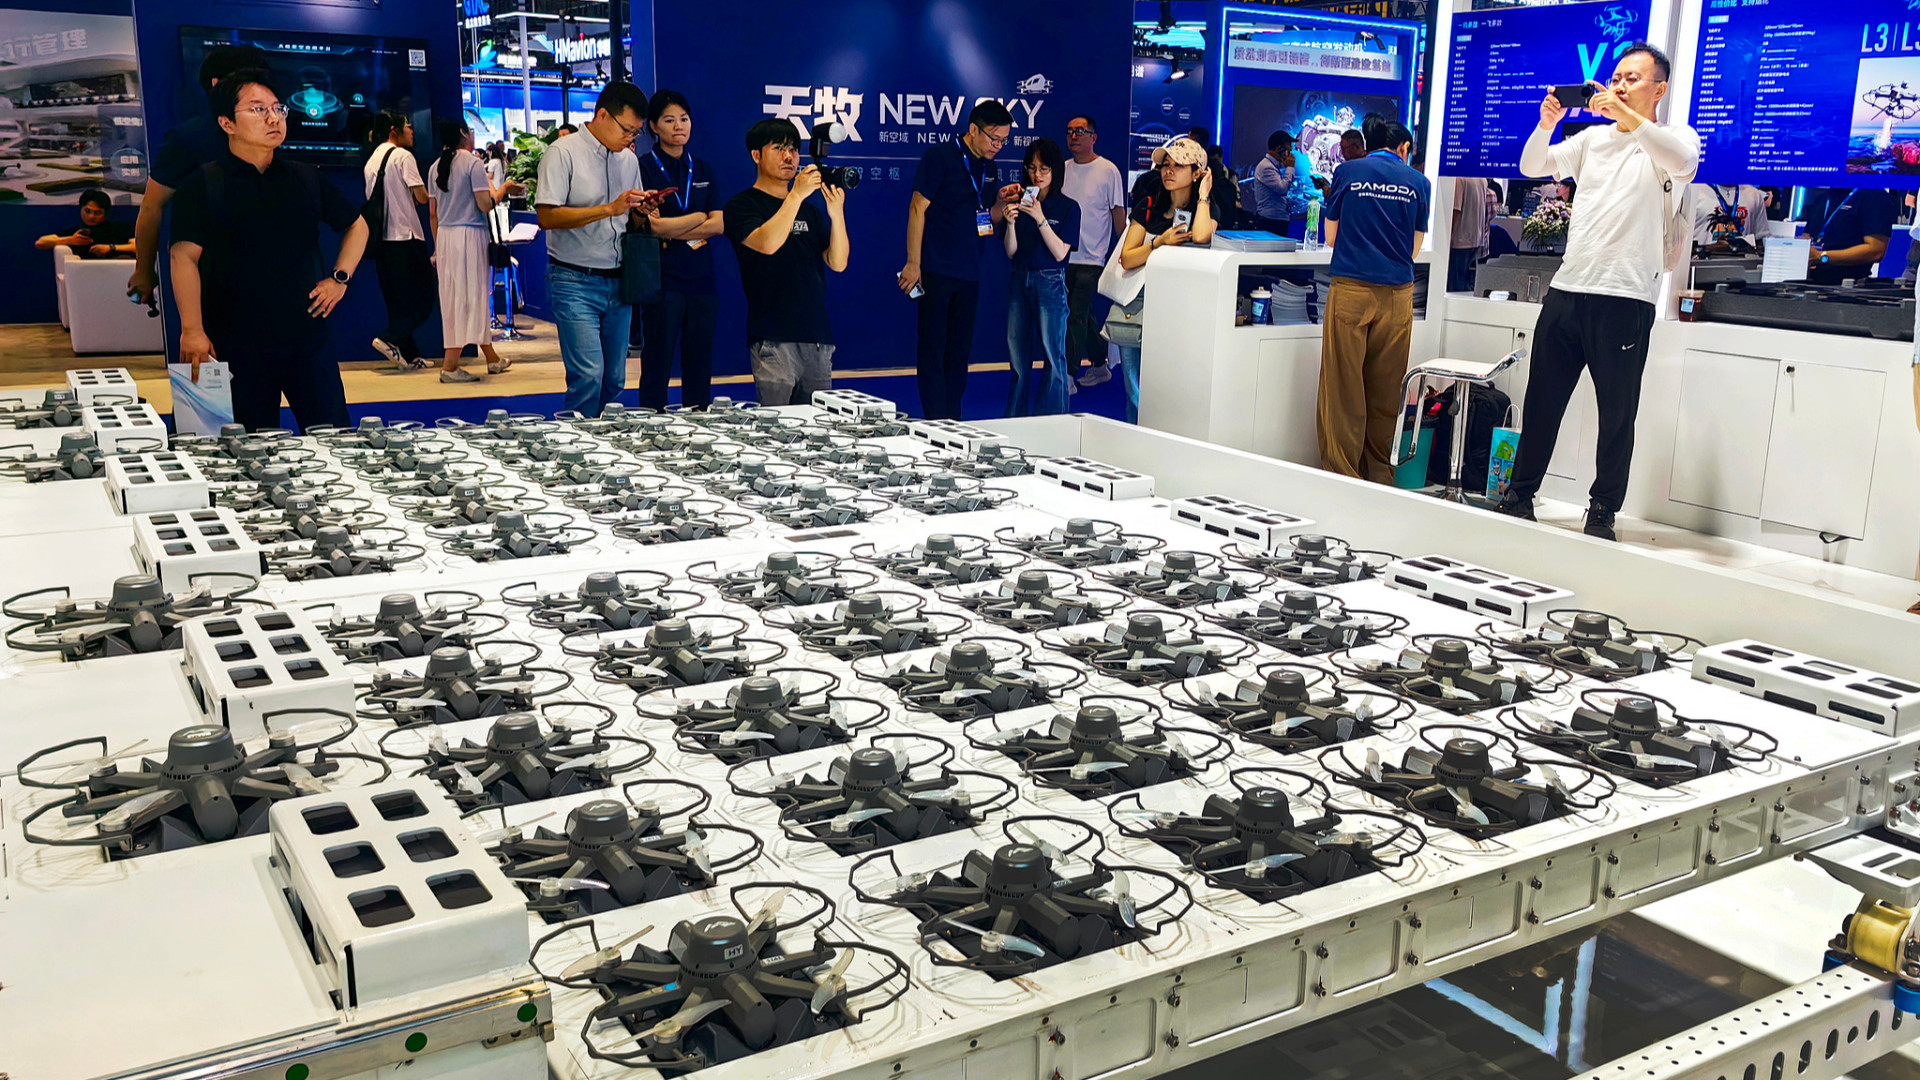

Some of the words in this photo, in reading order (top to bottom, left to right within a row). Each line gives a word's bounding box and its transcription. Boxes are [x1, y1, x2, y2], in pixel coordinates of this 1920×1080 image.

[555, 33, 597, 64] HMavion
[1861, 22, 1889, 53] L3
[763, 84, 865, 142] 天牧
[878, 92, 966, 126] NEW
[974, 96, 1045, 129] KY
[879, 131, 909, 144] 新空域
[917, 131, 951, 144] NEW
[1350, 181, 1418, 200] DAMODA
[727, 945, 743, 958] HY
